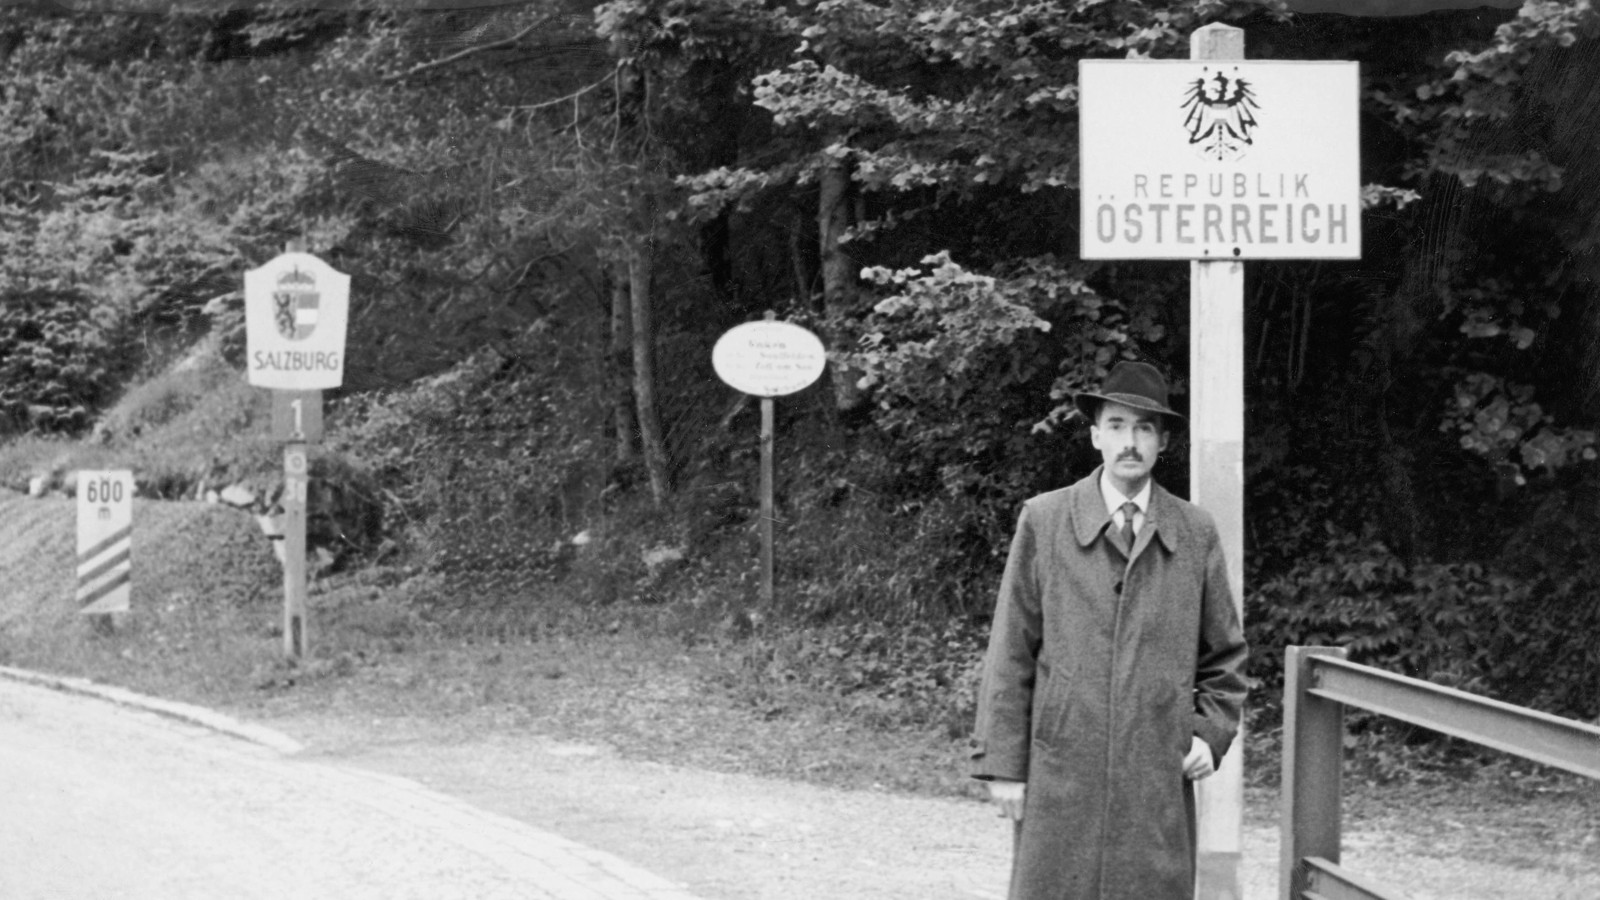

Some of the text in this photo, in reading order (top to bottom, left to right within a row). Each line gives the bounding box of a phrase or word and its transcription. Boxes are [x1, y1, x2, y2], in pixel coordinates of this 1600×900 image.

[1134, 172, 1310, 198] REPUBLIK
[1096, 194, 1348, 244] ÖSTERREICH
[254, 350, 339, 371] SALZBURG
[290, 398, 304, 439] 1
[87, 480, 123, 503] 600
